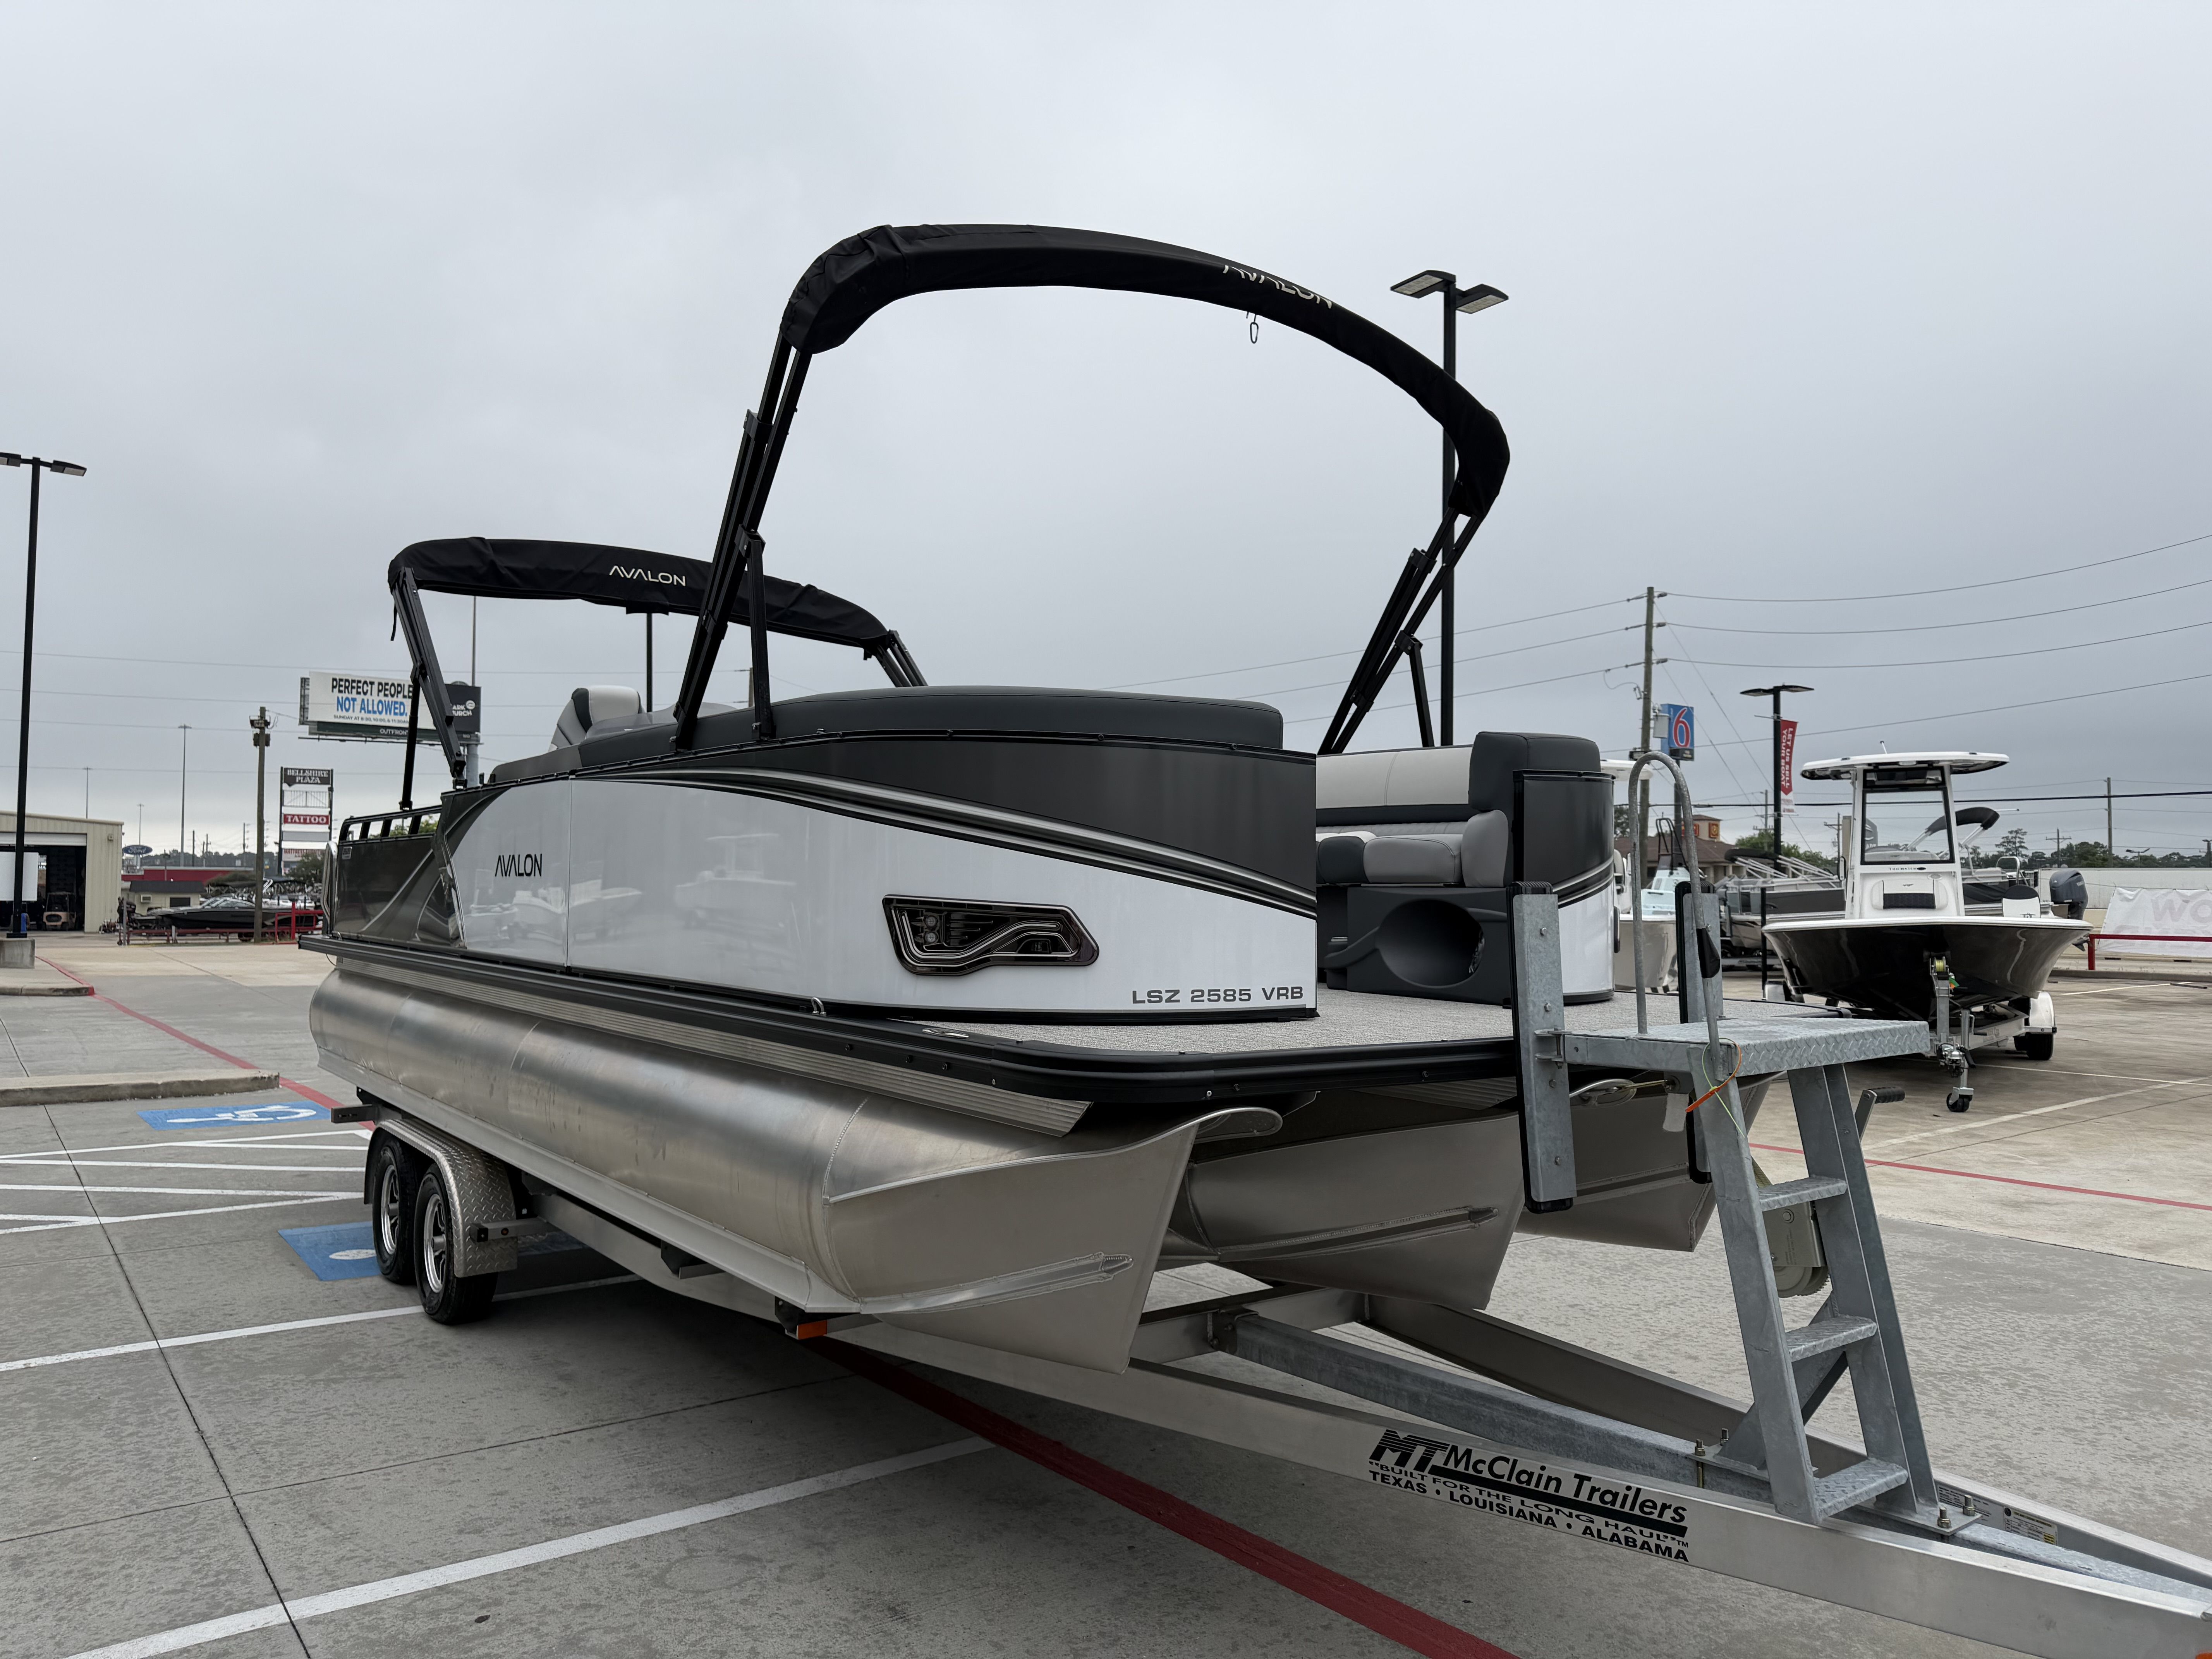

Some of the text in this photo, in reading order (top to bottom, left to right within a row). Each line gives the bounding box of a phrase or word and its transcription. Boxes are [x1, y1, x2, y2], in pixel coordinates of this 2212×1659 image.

[609, 565, 686, 587] AVALON
[331, 677, 414, 699] PERFECT PEOPLE
[337, 696, 407, 716] NOT ALLOWED.
[1673, 707, 1691, 748] 6
[1786, 749, 1791, 762] US
[287, 769, 328, 777] BELLSHIRE
[286, 815, 327, 824] TATTOO
[495, 854, 542, 877] AVALON
[1132, 986, 1303, 1004] LSZ 2585 VRB
[1443, 1444, 1562, 1494] McClain
[1573, 1473, 1688, 1523] Trailers
[1432, 1477, 1470, 1492] FOR
[1475, 1488, 1511, 1503] THE
[1520, 1499, 1595, 1524] LONG
[1369, 1470, 1689, 1563] TEXAS LOUISIANA ALABAMA
